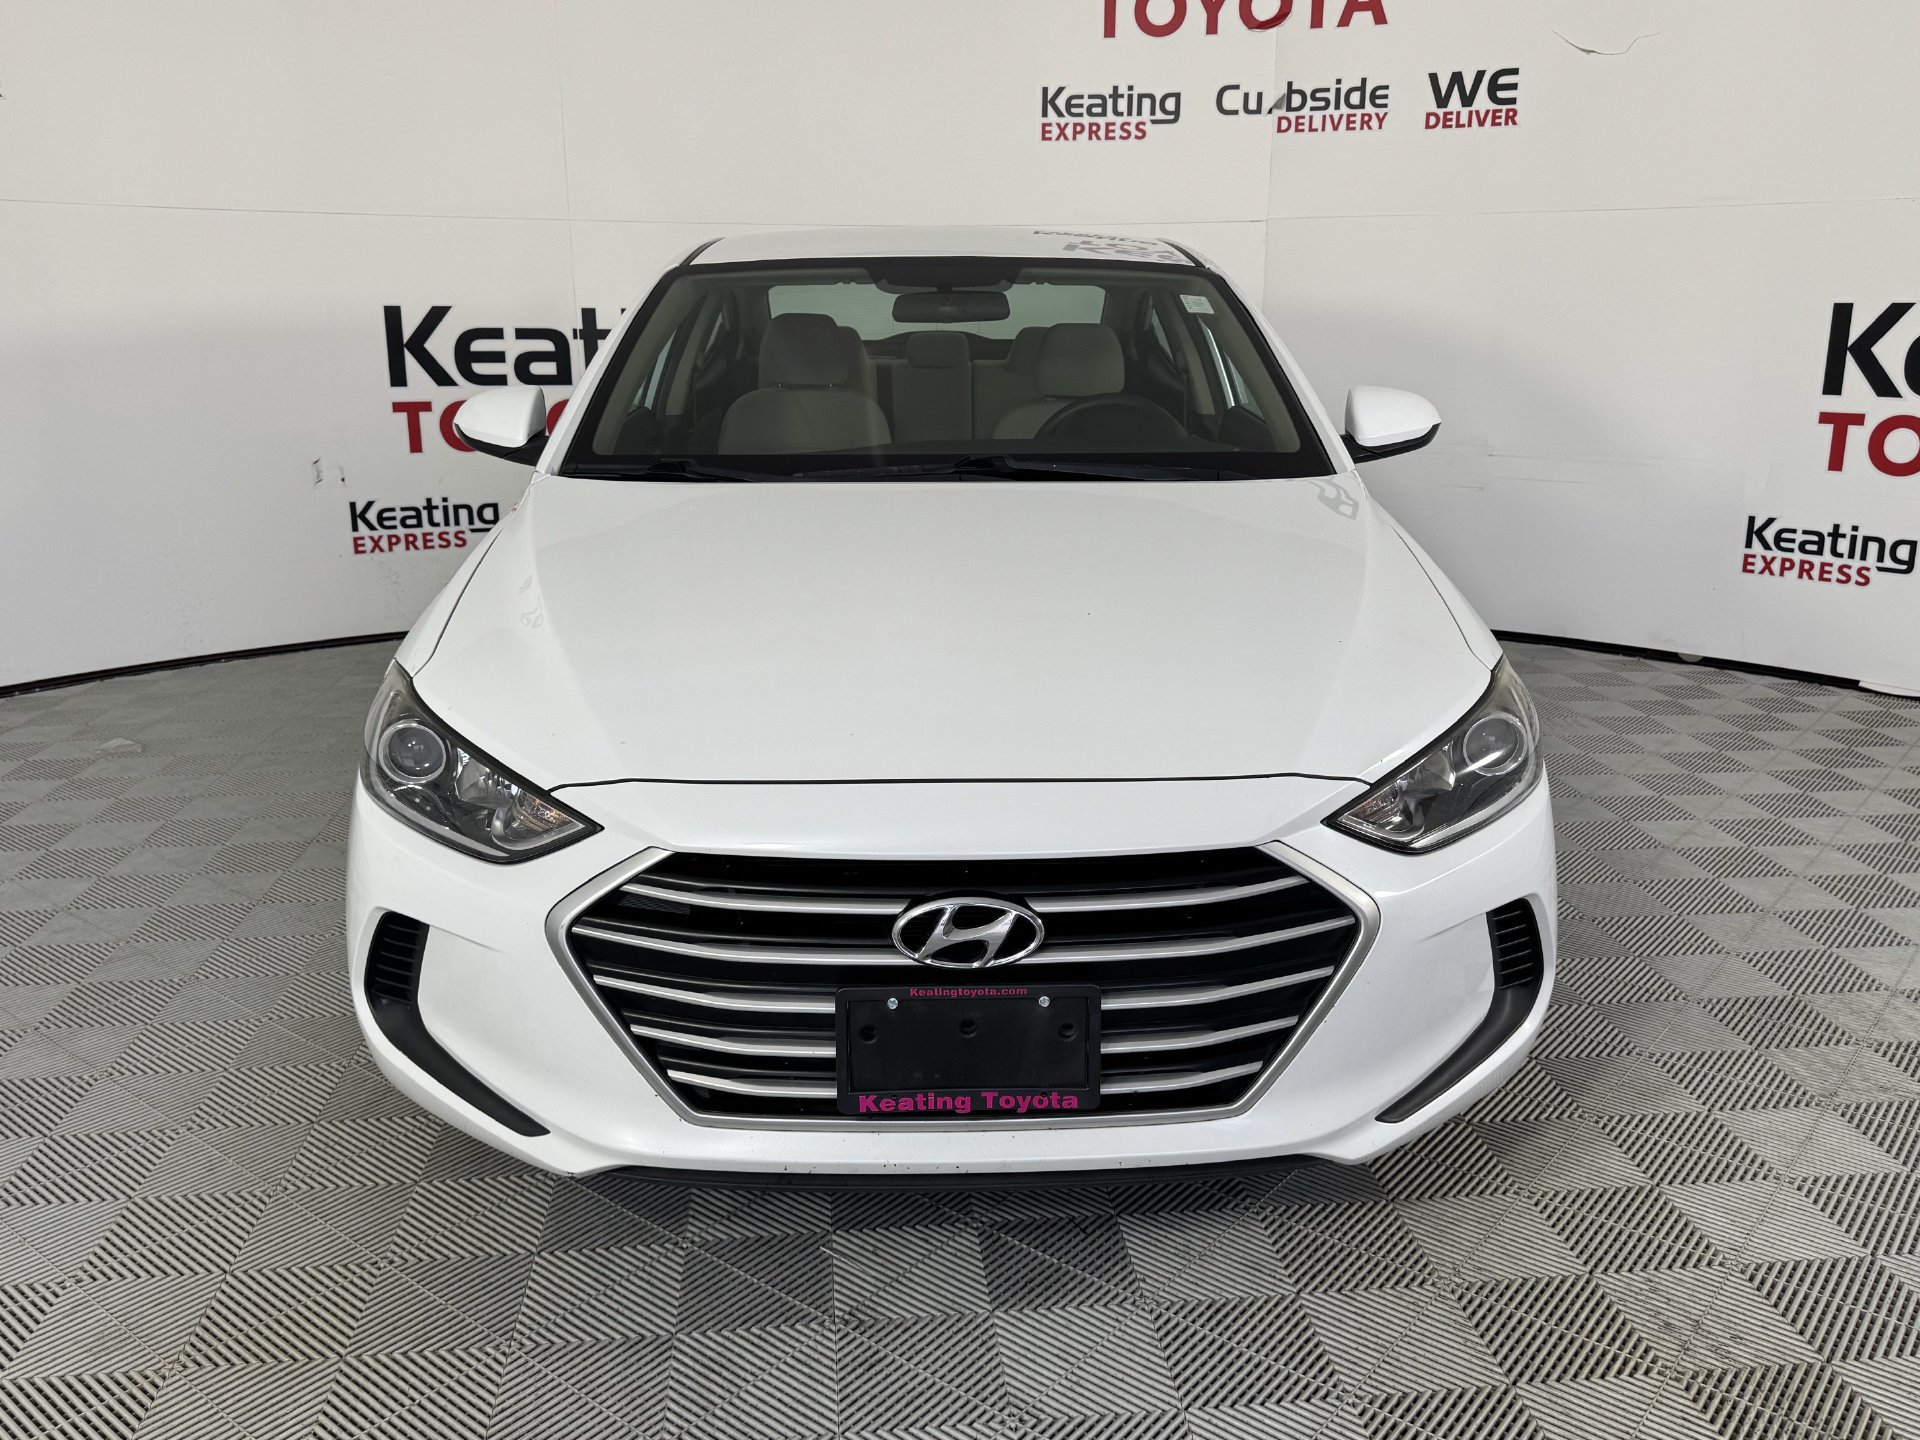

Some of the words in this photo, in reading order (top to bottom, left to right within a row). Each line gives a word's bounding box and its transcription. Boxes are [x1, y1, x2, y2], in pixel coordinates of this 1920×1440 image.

[1041, 85, 1181, 124] Keating
[1216, 77, 1390, 116] Cubside
[1428, 67, 1520, 109] WE
[1041, 121, 1147, 141] EXPRESS
[1276, 112, 1388, 134] DELIVERY
[1424, 107, 1518, 130] DELIVER
[384, 305, 627, 387] Keat
[349, 497, 500, 533] Keating
[352, 530, 467, 555] EXPRESS
[1744, 515, 1918, 575] Keating
[1741, 553, 1871, 587] EXPRESS
[909, 986, 1028, 998] Keatingtoyota.com
[859, 1092, 971, 1114] Keating
[981, 1091, 1079, 1114] Toyota
